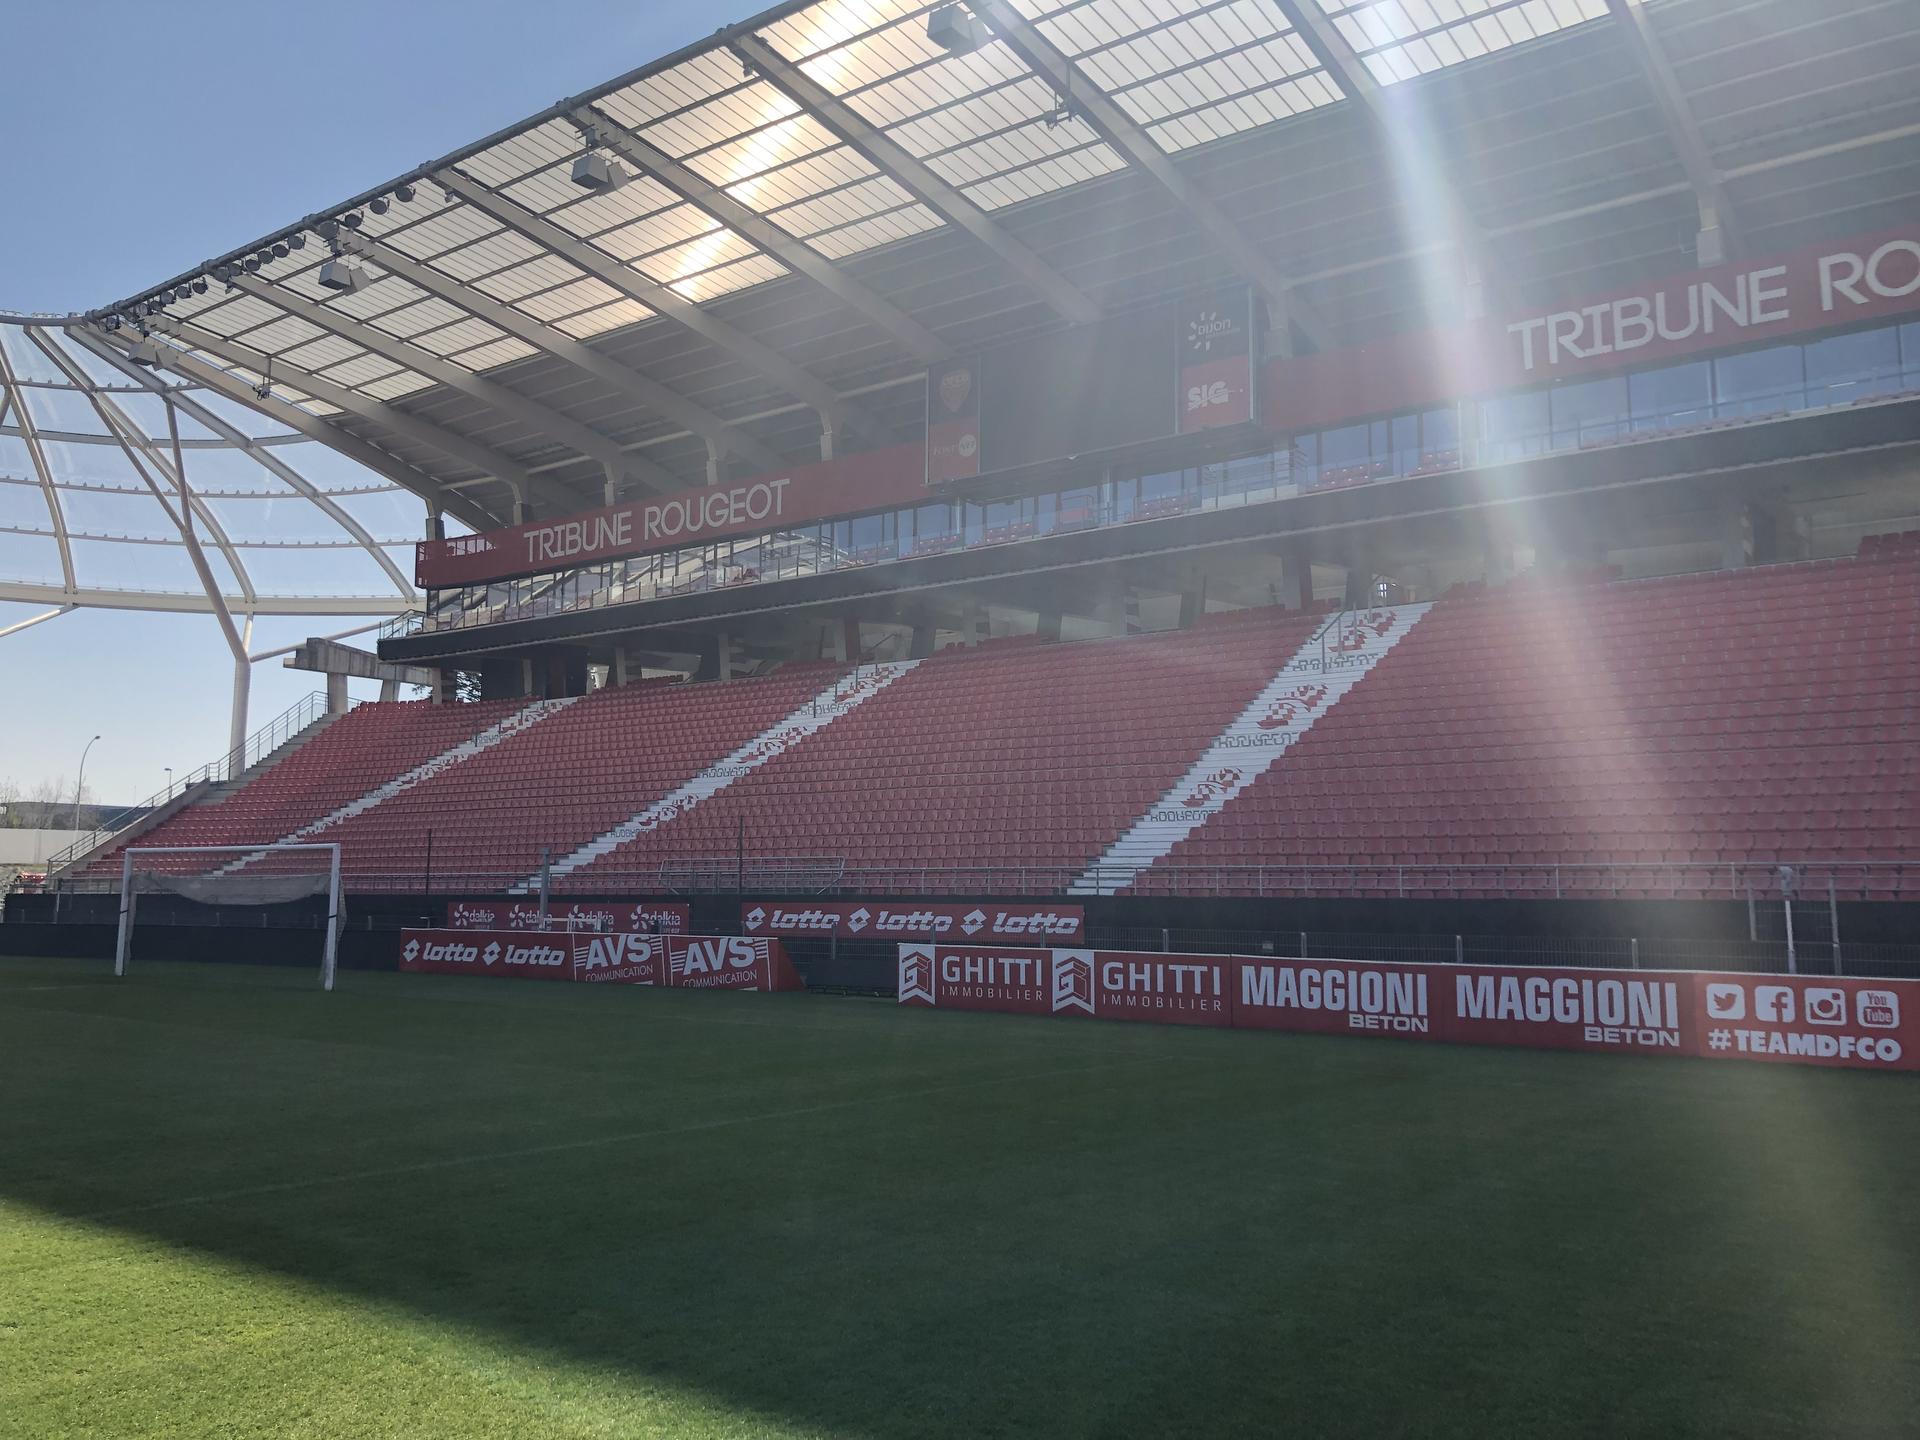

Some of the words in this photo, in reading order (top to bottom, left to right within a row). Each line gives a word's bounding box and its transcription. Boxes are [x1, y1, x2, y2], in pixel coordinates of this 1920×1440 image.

[1507, 265, 1789, 371] TRIBUNE
[1188, 381, 1229, 411] SIG
[524, 510, 632, 562] TRIBUNE
[644, 478, 791, 540] ROUGEOT
[770, 910, 840, 929] lotto
[875, 911, 952, 932] lotto
[992, 912, 1079, 934] lotto
[423, 943, 478, 962] lotto
[505, 944, 566, 966] lotto
[585, 935, 651, 970] AVS
[683, 938, 756, 975] AVS
[585, 964, 653, 982] COMMUNICATION
[683, 969, 757, 987] COMMUNICATION
[942, 956, 1042, 986] GHITTI
[1103, 961, 1221, 995] GHITTI
[942, 985, 1043, 1001] IMMOBILIER
[1241, 965, 1428, 1016] MAGGIONI
[1455, 974, 1679, 1028] MAGGIONI
[1867, 992, 1888, 1006] You
[1103, 994, 1221, 1012] IMMOBILIER
[1348, 1013, 1428, 1032] BETON
[1865, 1008, 1893, 1023] Tube
[1584, 1026, 1680, 1047] BETON
[1708, 1028, 1902, 1062] #TEAMDFCO
